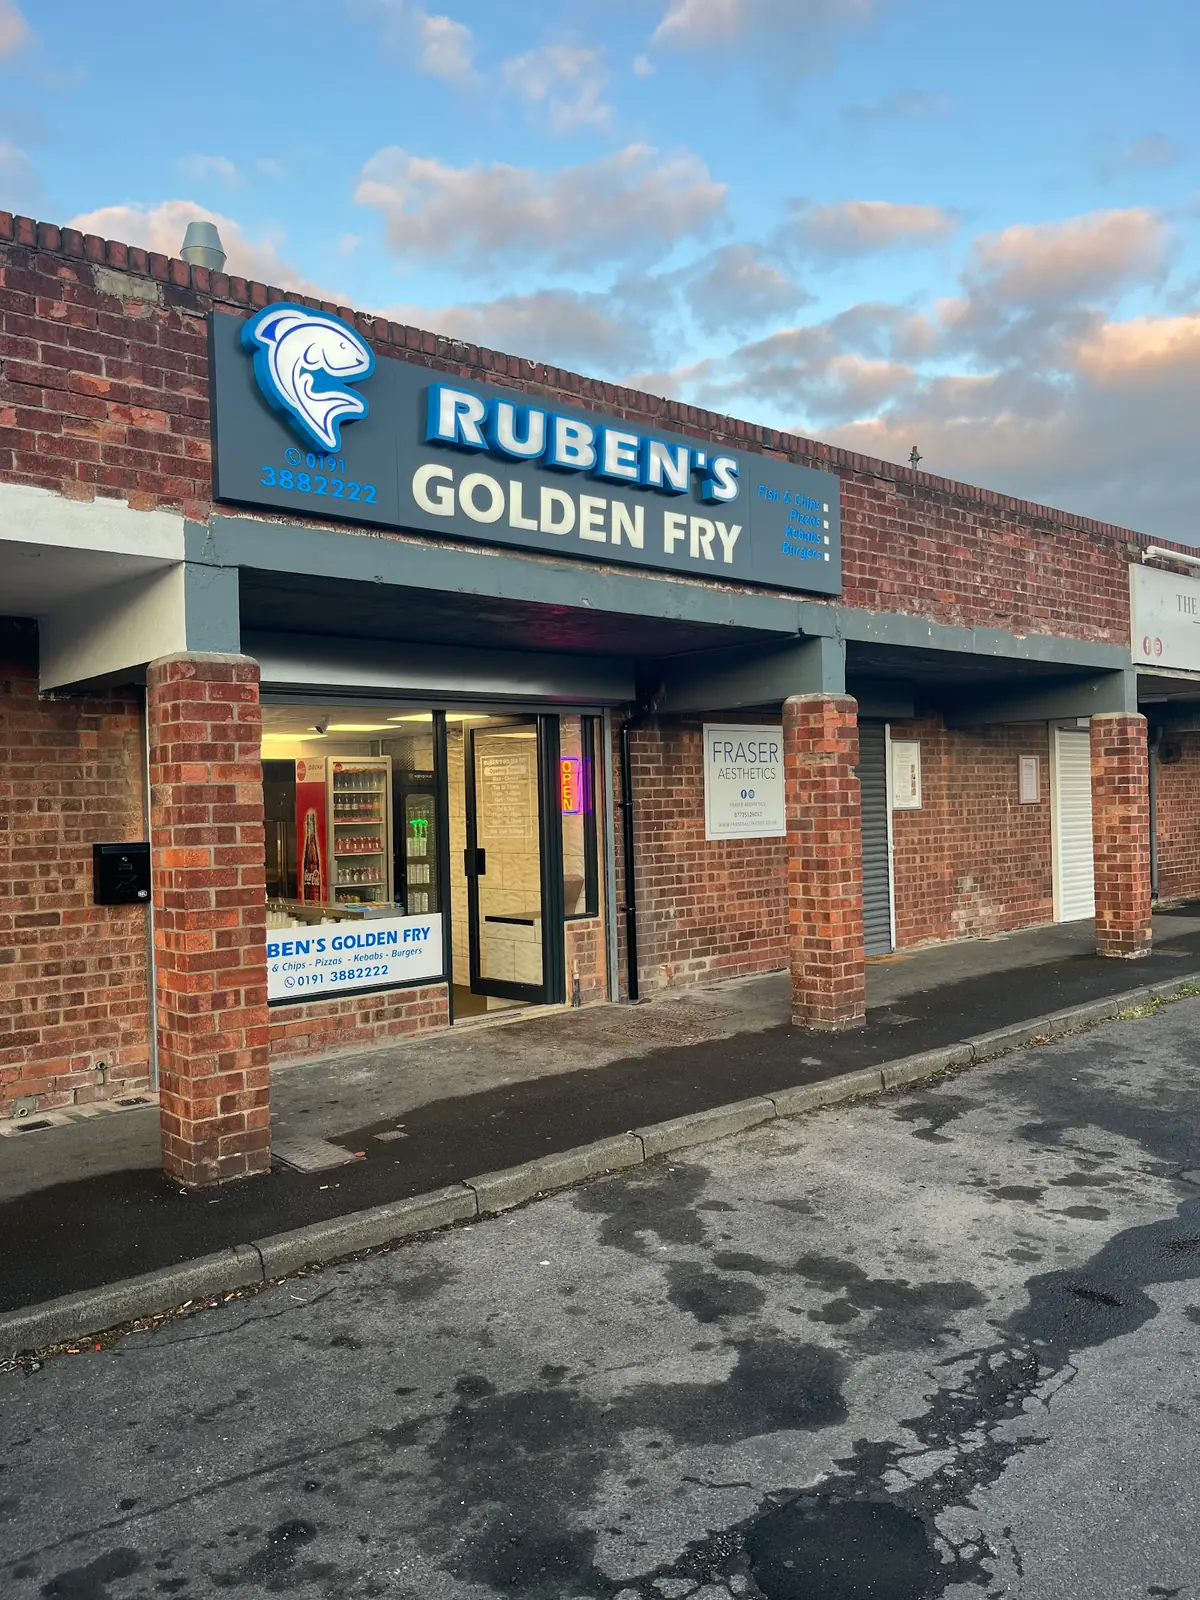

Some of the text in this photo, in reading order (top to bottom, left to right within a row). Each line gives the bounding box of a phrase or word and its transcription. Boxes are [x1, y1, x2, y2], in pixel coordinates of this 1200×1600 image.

[432, 383, 740, 504] RUBEN'S
[305, 452, 346, 474] 0191
[260, 465, 378, 505] 3882222
[757, 484, 821, 512] Fish & Chips
[412, 463, 743, 564] GOLDEN FRY
[789, 508, 821, 527] Pizzas
[785, 525, 821, 544] Kebabs
[782, 541, 822, 560] Burgers
[1176, 594, 1198, 616] THE
[713, 741, 779, 763] FRASER
[718, 767, 776, 780] AESTHETICS
[561, 760, 573, 811] OPEN
[267, 927, 431, 958] BEN'S GOLDEN FRY
[272, 963, 279, 973] &
[282, 961, 306, 972] Chips
[315, 957, 342, 967] Pizzas
[353, 952, 383, 963] Kebabs
[391, 947, 422, 958] Burgers
[297, 965, 389, 986] 0191 3882222
